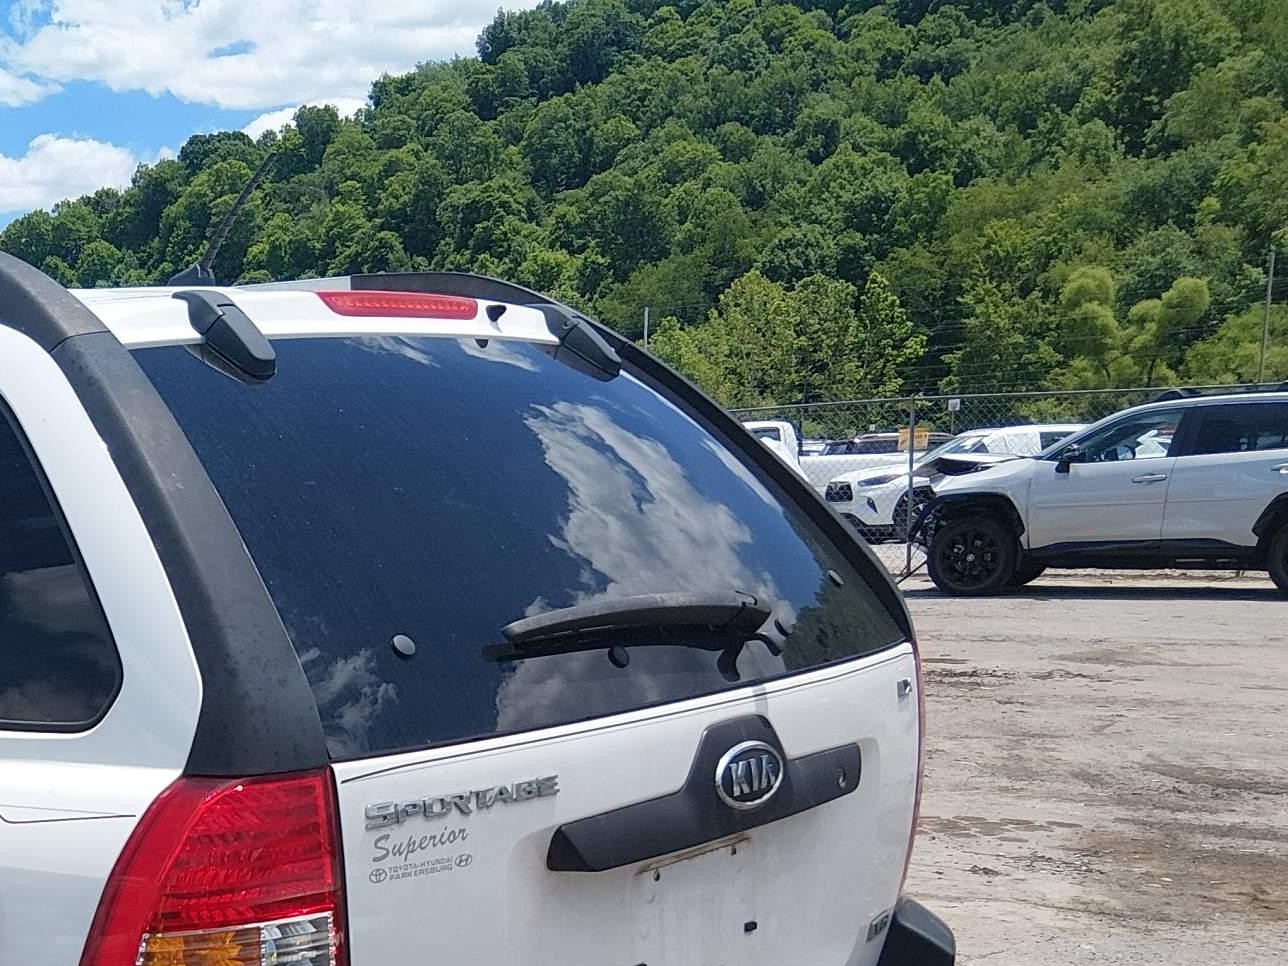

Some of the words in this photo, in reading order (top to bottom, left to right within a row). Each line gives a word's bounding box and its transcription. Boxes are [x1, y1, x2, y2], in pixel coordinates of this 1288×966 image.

[728, 754, 776, 797] KIA
[365, 774, 561, 831] SPORTAGE
[372, 826, 469, 863] Superior
[389, 856, 454, 874] TOYOTA-HYUNDAI
[389, 863, 453, 881] PARKERSBURG
